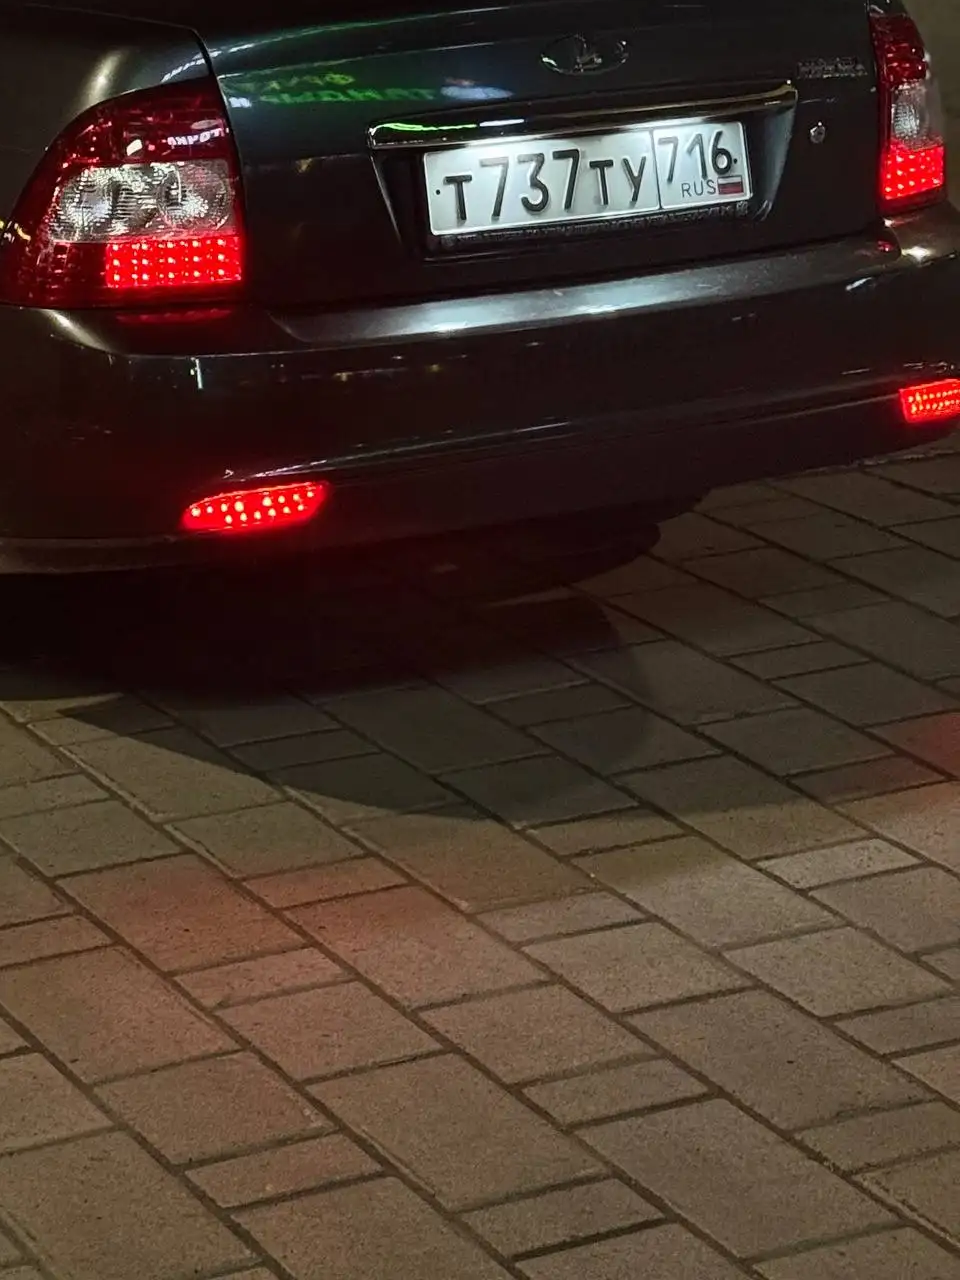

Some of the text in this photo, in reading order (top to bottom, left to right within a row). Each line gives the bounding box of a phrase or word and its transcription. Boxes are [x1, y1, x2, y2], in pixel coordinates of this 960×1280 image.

[443, 130, 733, 221] Т737ТУ 716
[681, 178, 717, 198] RUS
